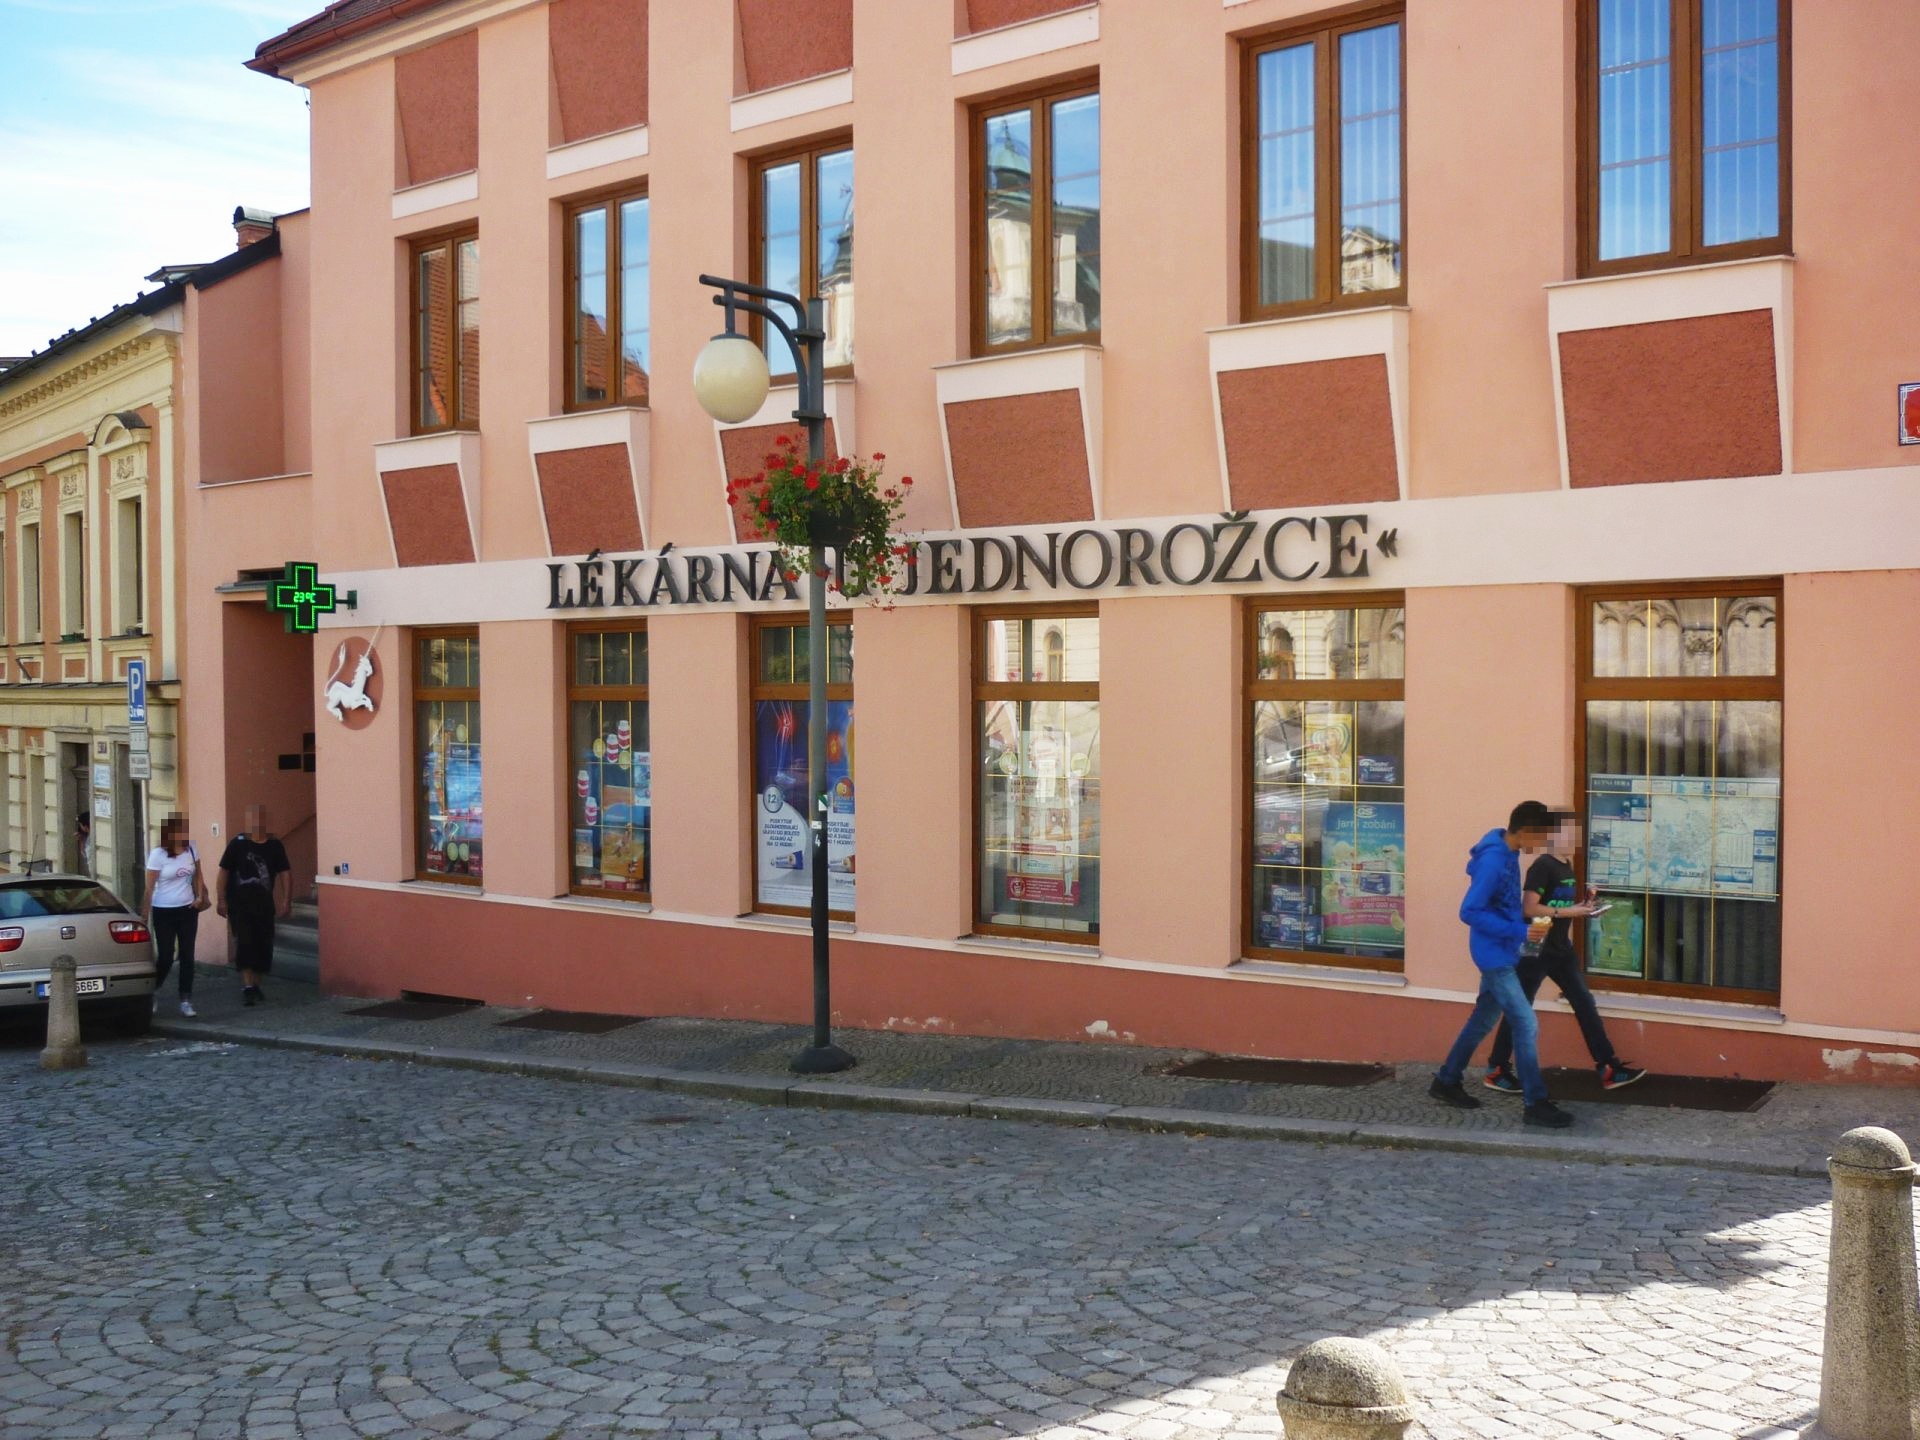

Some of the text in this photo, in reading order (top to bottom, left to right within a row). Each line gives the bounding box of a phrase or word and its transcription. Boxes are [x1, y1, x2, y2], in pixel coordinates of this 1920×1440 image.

[546, 542, 800, 608] LÉKÁRNA
[293, 591, 316, 604] 23°C
[130, 668, 141, 703] P
